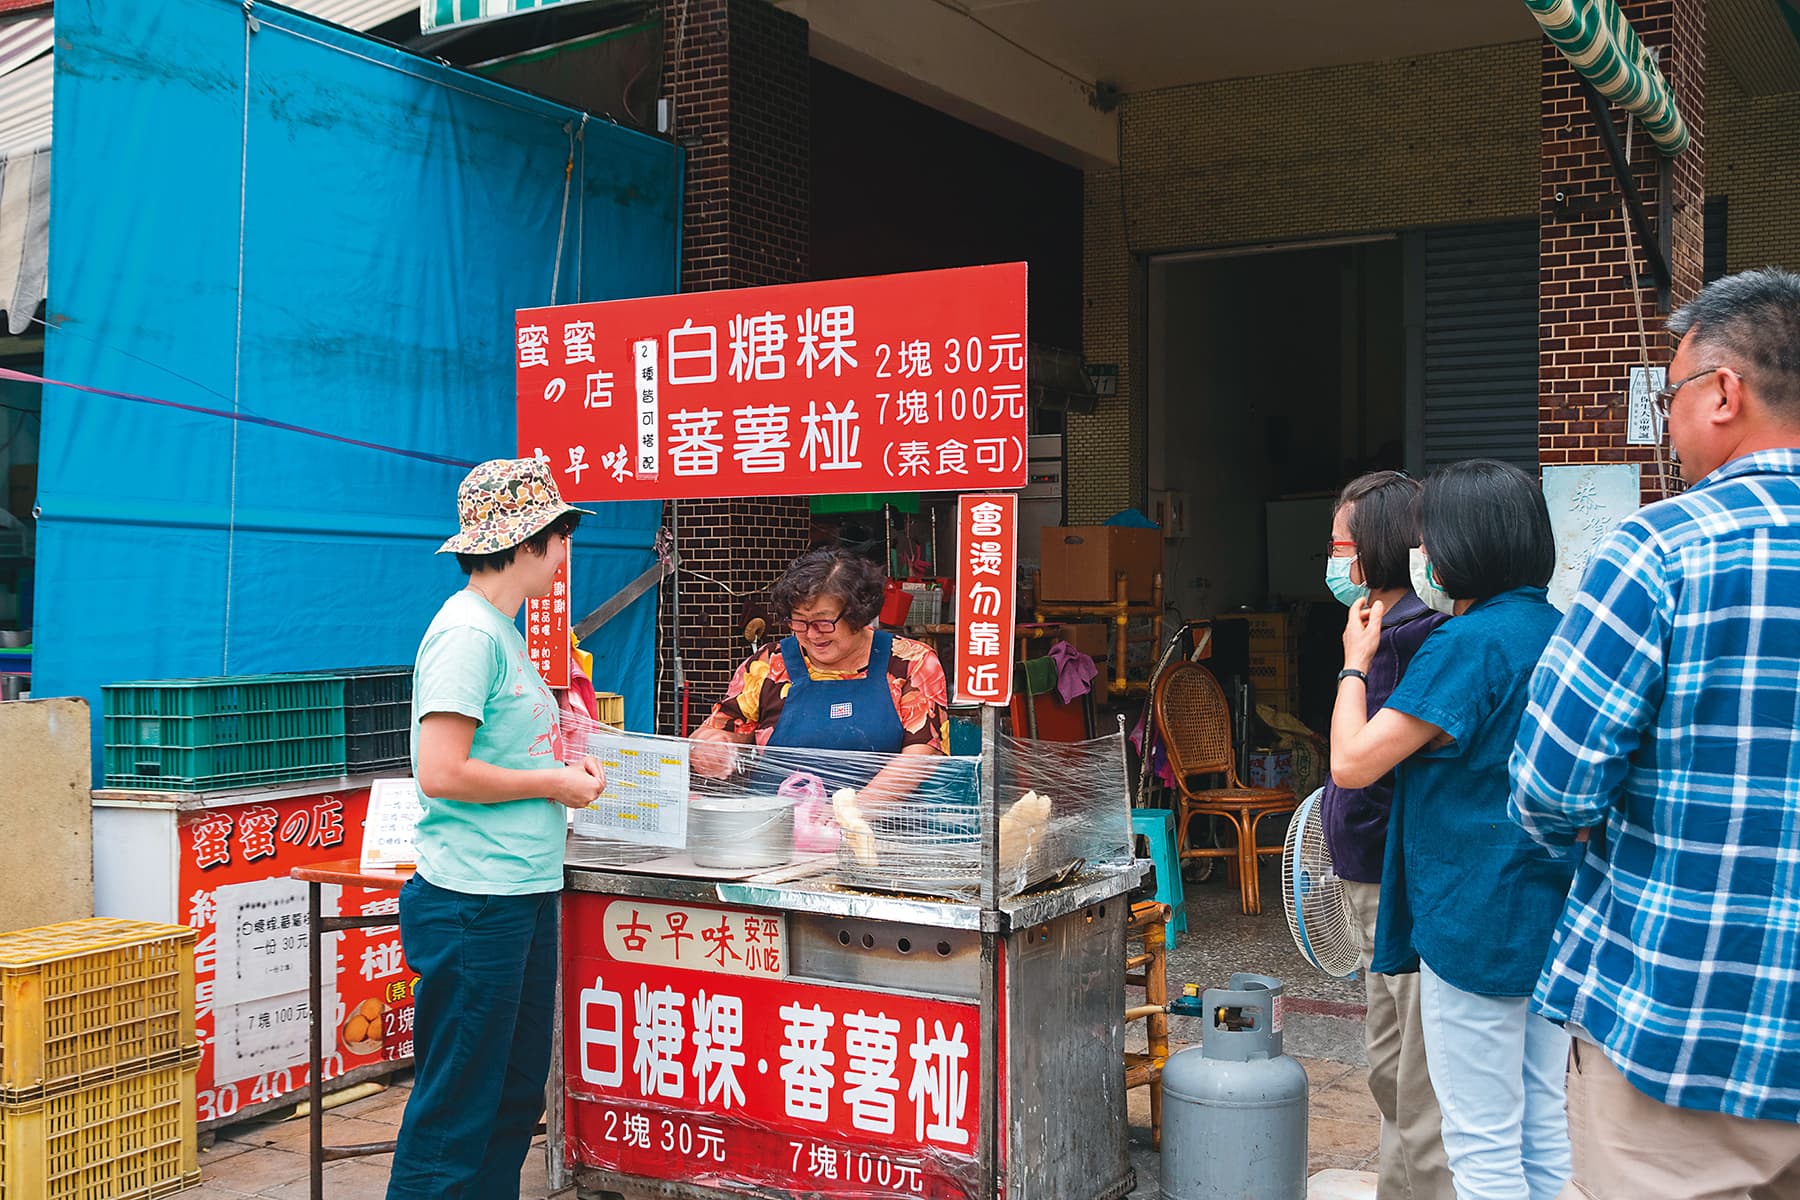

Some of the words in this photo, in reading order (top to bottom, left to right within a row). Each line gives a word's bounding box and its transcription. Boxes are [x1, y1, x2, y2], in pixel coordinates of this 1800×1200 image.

[518, 321, 596, 369] 蜜蜜
[667, 304, 858, 386] 白糖粿
[876, 384, 1024, 425] 7塊100元
[667, 399, 862, 476] 蕃薯椪
[882, 438, 1024, 479] (素食可)
[967, 501, 1004, 697] 會燙勿靠近
[191, 795, 345, 870] 蜜蜜の店
[616, 909, 742, 967] 古早味
[744, 916, 779, 945] 安平
[744, 946, 780, 973] 小吃
